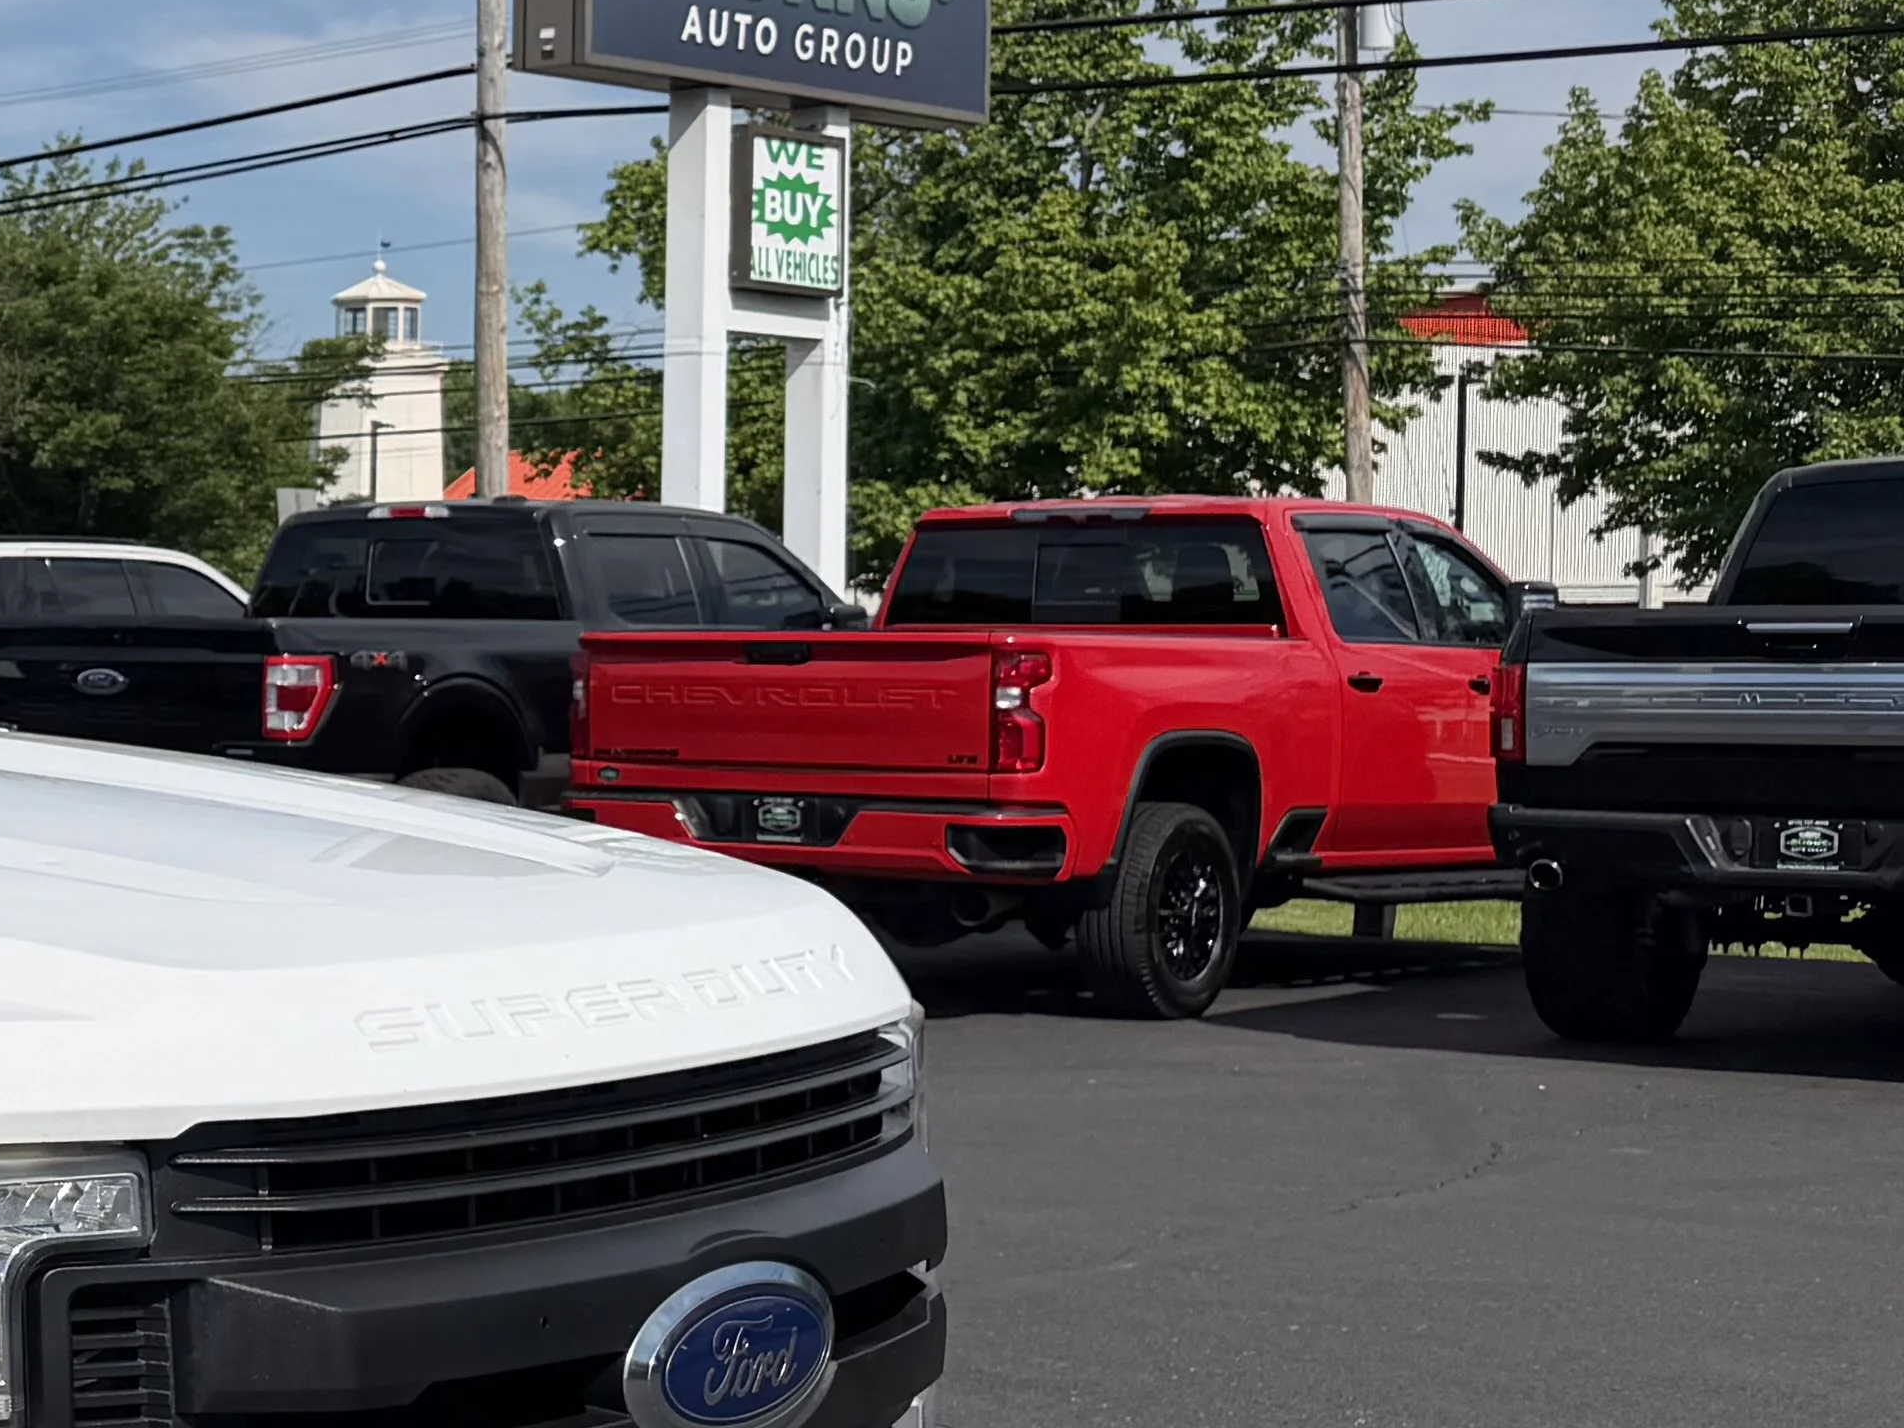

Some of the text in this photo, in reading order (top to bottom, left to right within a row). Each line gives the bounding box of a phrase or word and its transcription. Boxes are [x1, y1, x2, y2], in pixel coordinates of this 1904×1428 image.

[681, 5, 913, 76] AUTO GROUP
[765, 139, 824, 170] WE
[764, 187, 824, 228] BUY
[775, 248, 840, 285] VEHICLES
[611, 683, 959, 710] CHEVROLET
[354, 943, 860, 1054] SUPER DUTY
[703, 1314, 798, 1407] Ford
